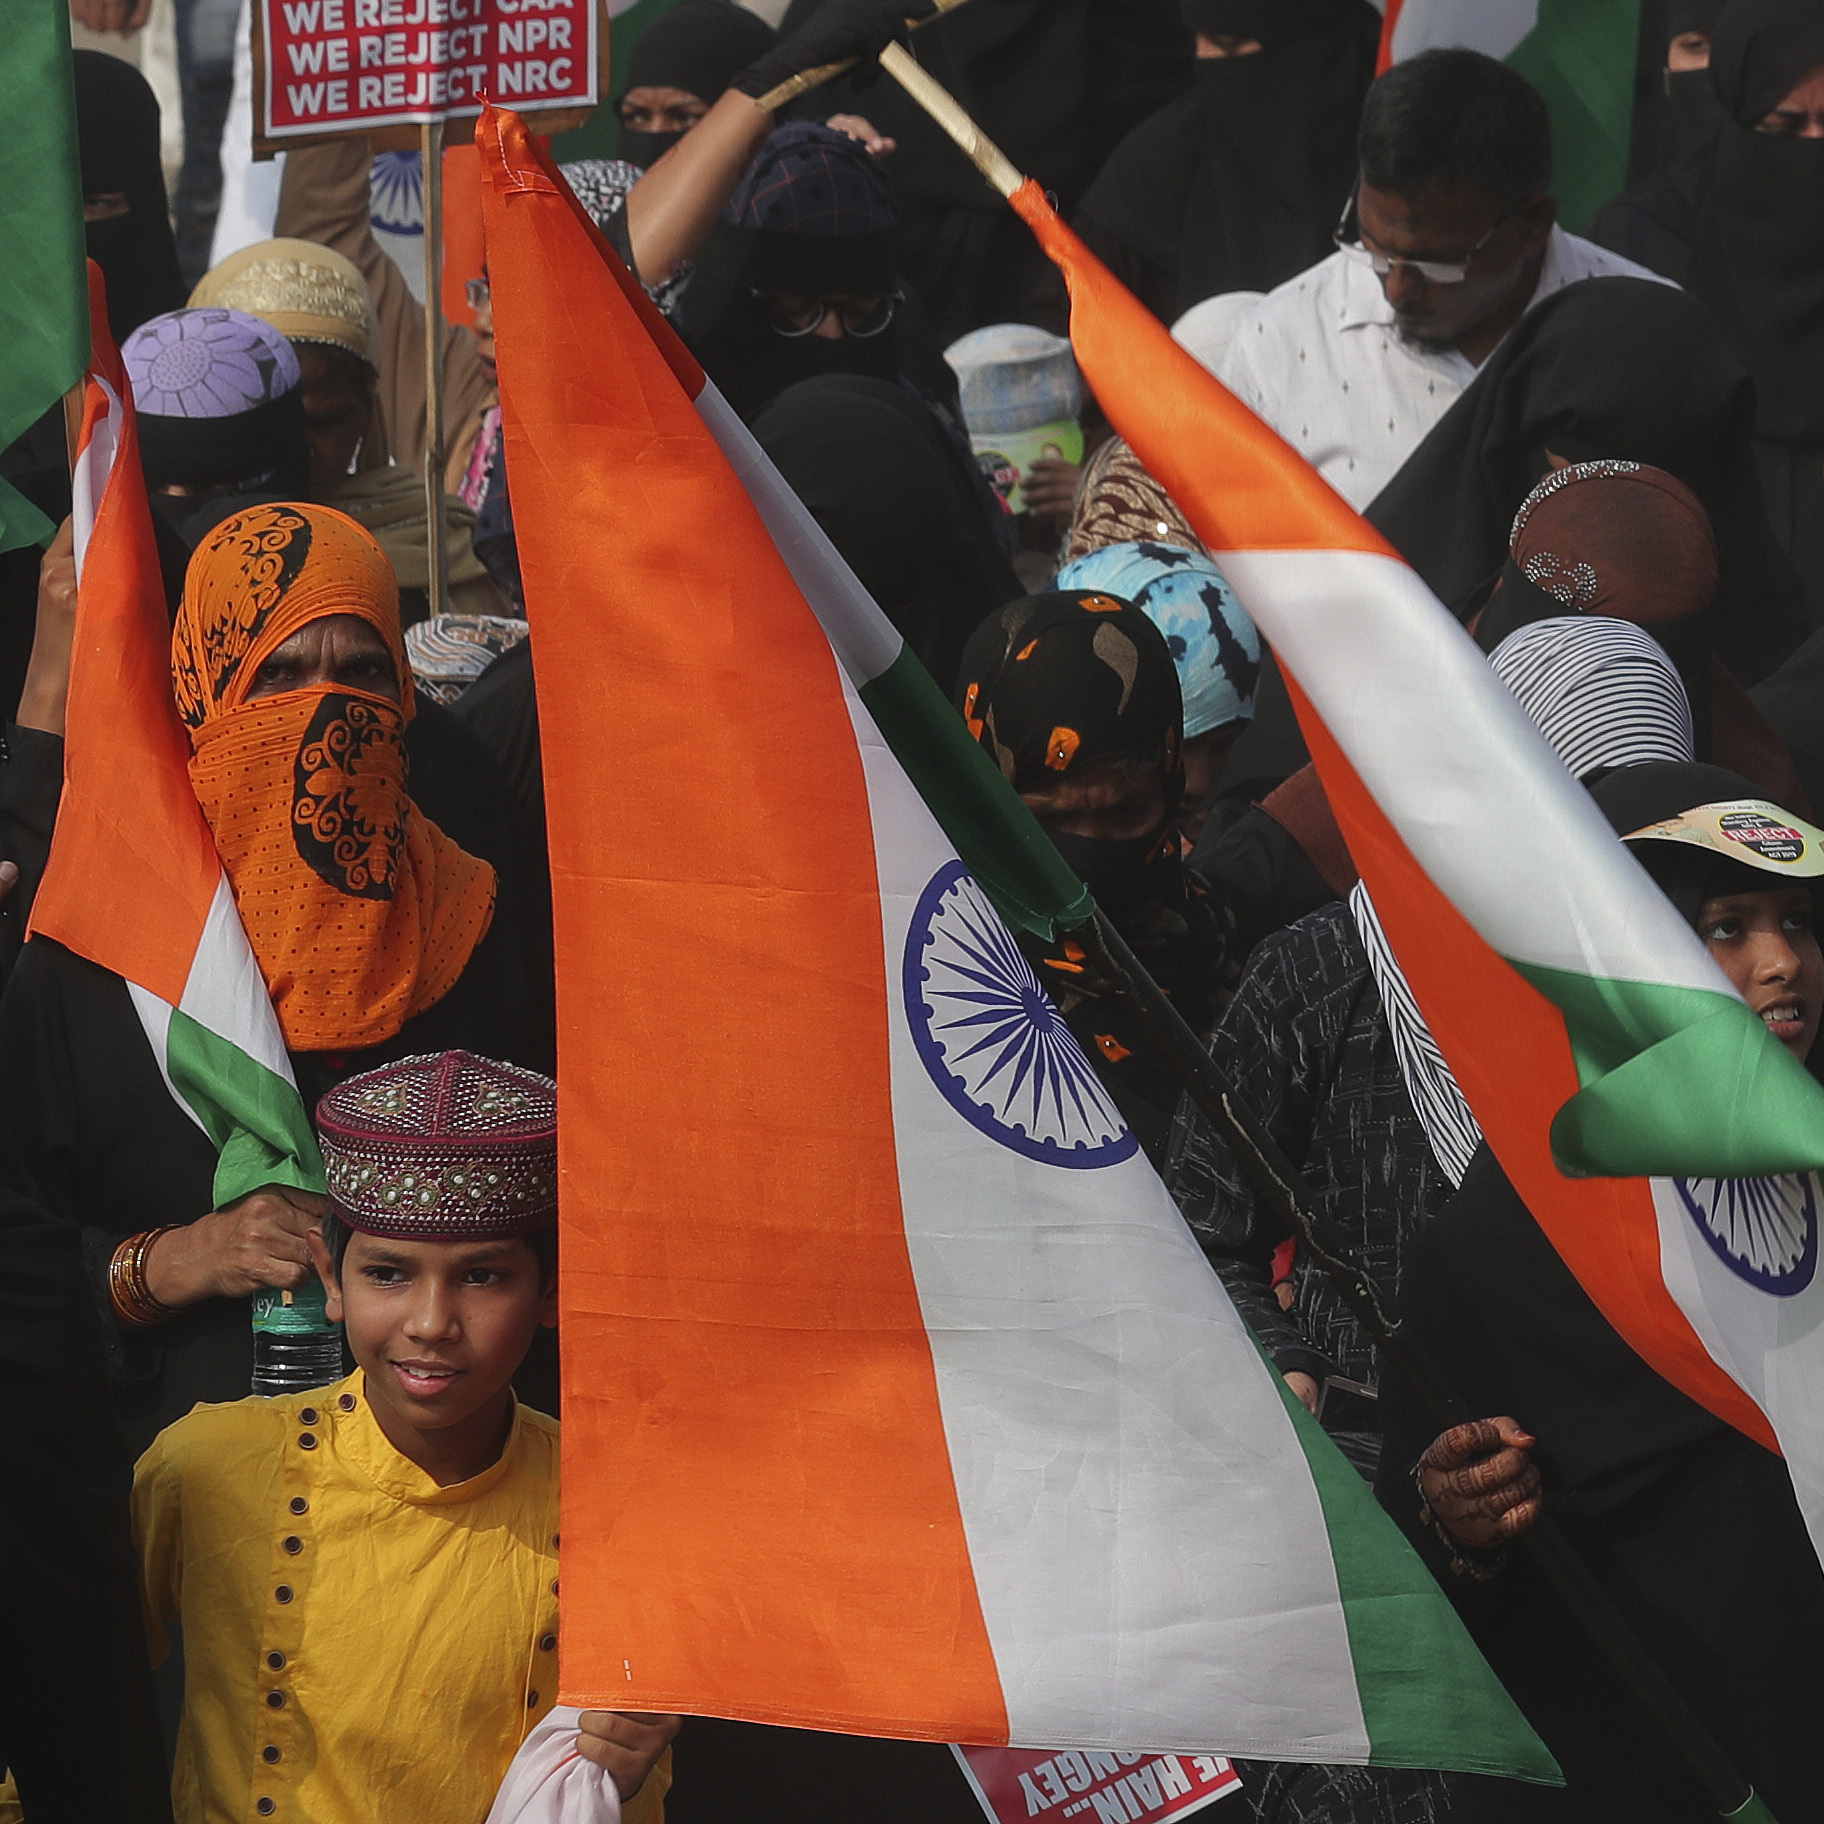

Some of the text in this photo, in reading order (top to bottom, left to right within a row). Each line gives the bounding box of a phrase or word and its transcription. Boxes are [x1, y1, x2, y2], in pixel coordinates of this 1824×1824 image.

[286, 17, 572, 77] WE REJECT NPR
[286, 58, 572, 117] WE REJECT NRC
[1727, 827, 1795, 841] REJECT
